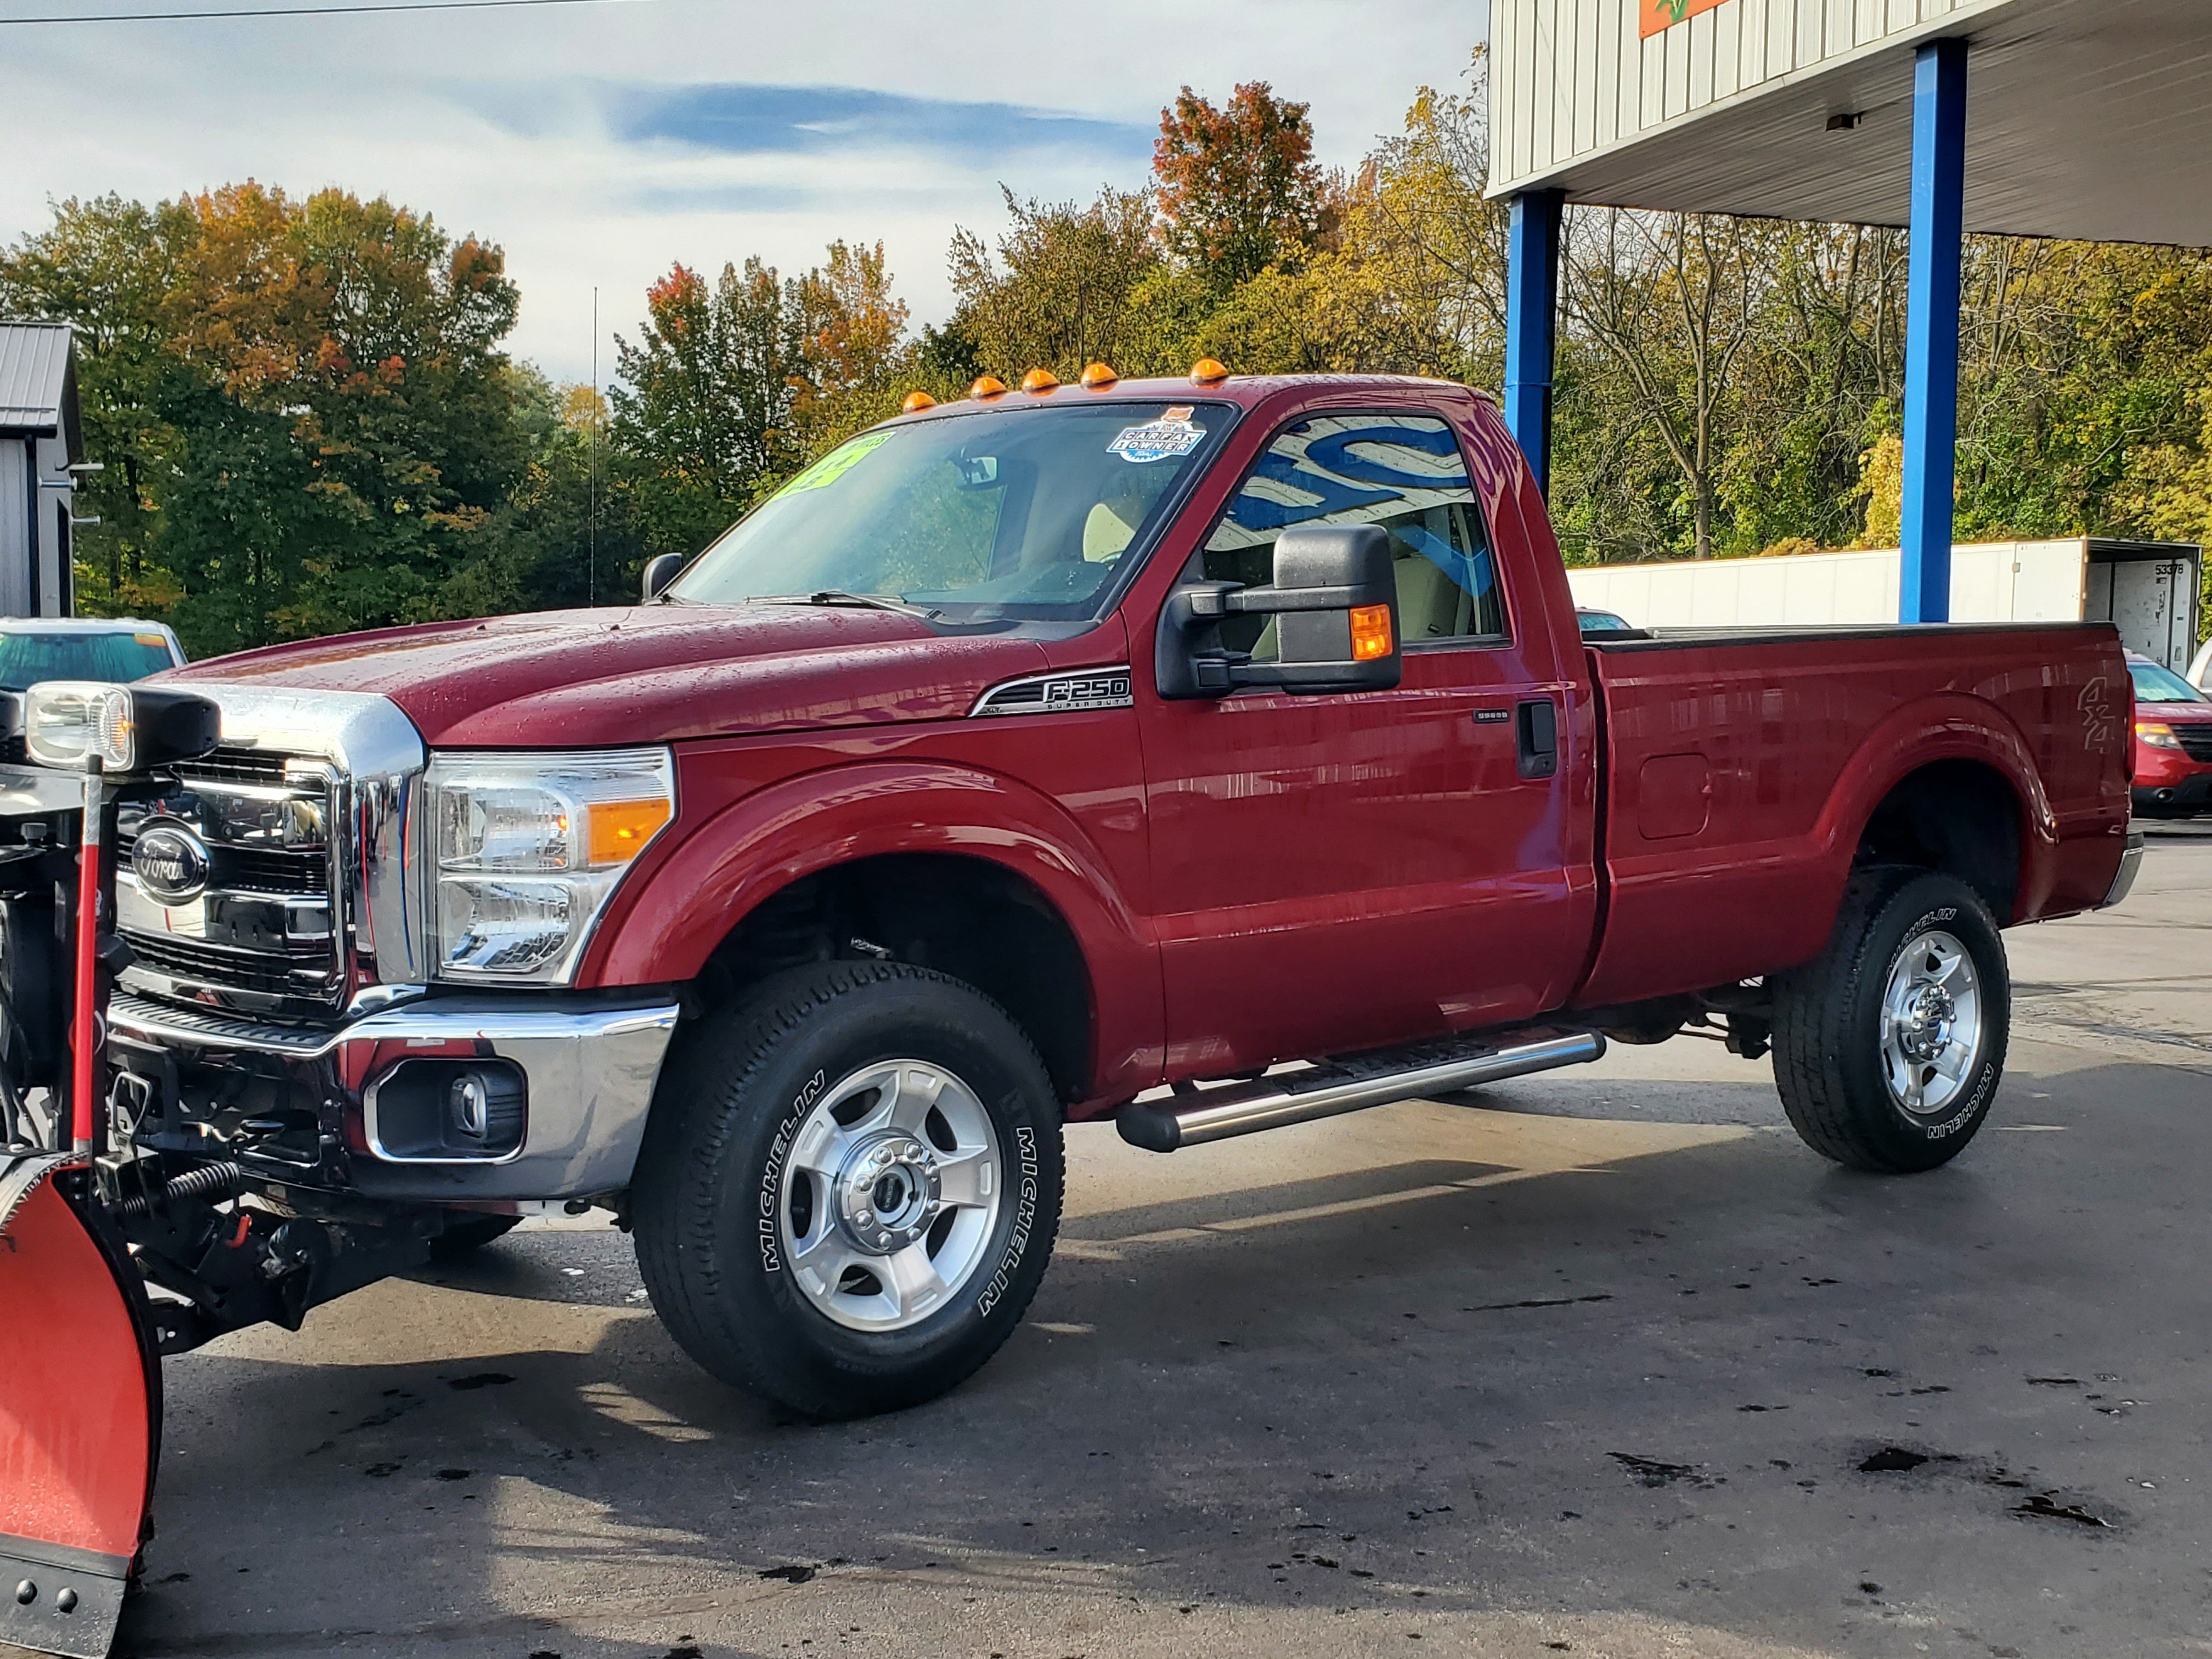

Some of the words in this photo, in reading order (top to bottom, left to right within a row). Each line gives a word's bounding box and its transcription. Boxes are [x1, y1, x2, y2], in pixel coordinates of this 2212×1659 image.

[1125, 431, 1195, 442] CARFAX
[1127, 442, 1189, 452] OWNER
[2155, 563, 2183, 575] 53378
[1043, 678, 1130, 703] F-250
[1047, 701, 1089, 709] SUPER
[1097, 698, 1129, 707] DUTY
[140, 839, 182, 880] Ford
[1927, 1062, 1994, 1139] MICHELIN
[760, 1069, 826, 1272] MICHELIN
[977, 1127, 1038, 1317] MICHELIN
